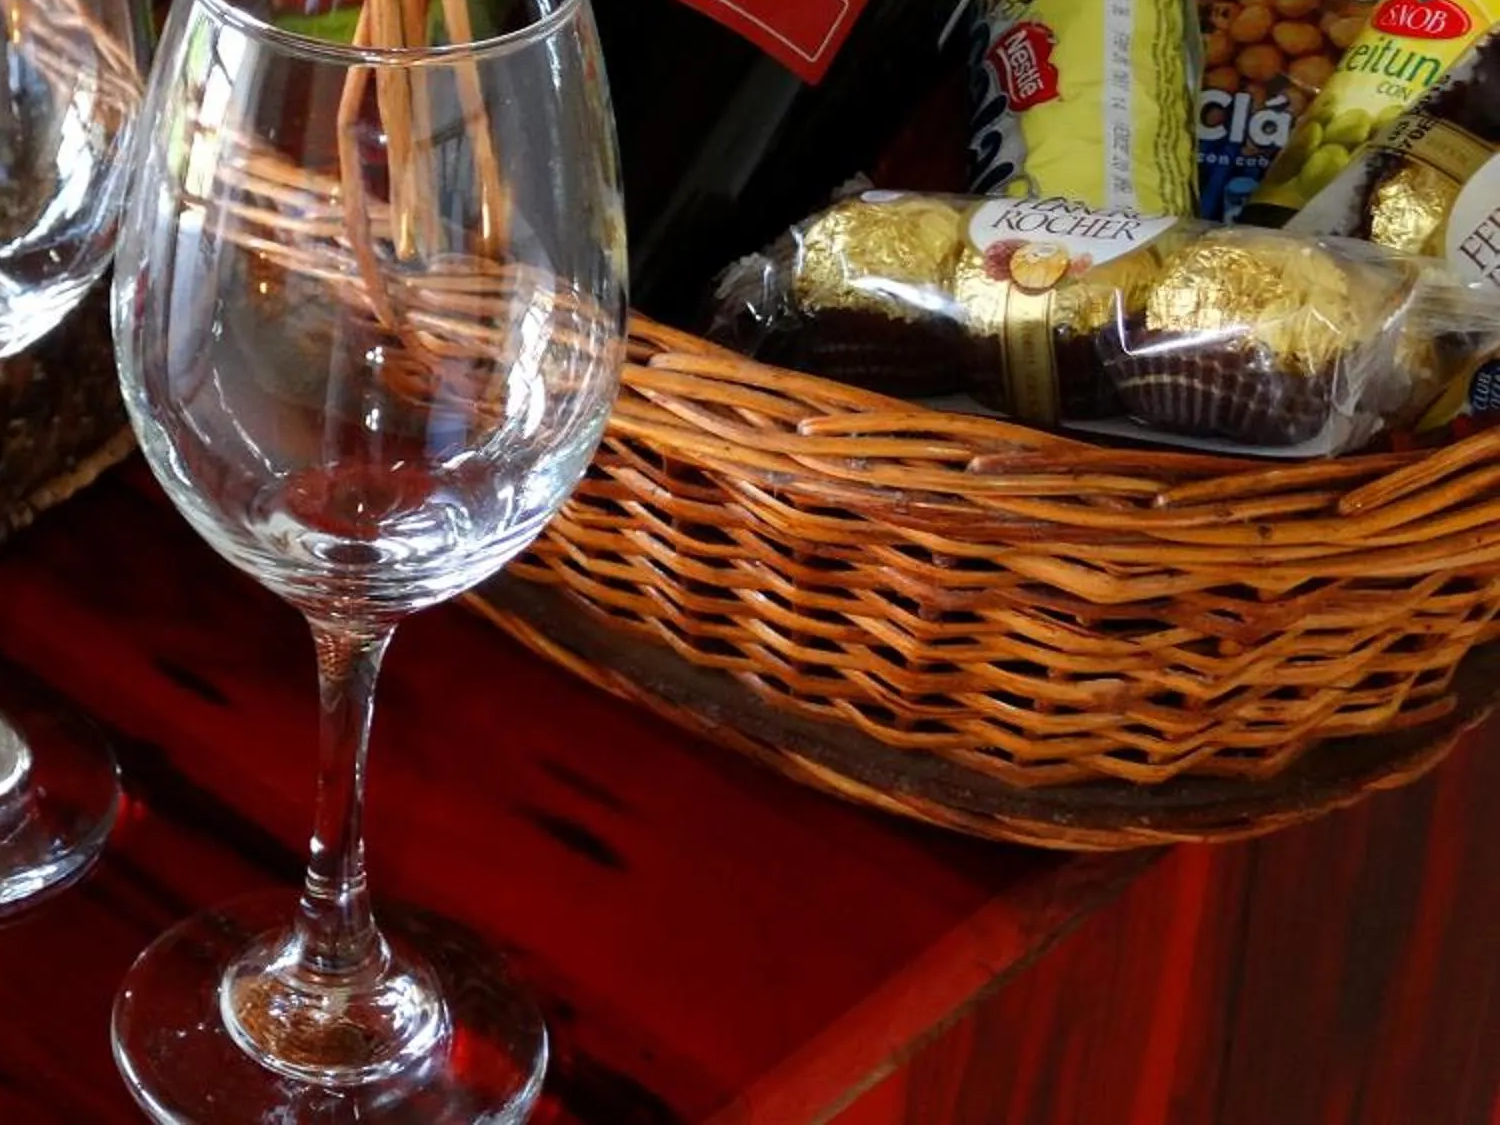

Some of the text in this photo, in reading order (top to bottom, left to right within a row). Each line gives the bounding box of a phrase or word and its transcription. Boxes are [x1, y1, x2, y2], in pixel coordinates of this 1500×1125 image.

[1380, 3, 1448, 34] SNOB
[1004, 29, 1045, 100] Nestlé
[992, 209, 1142, 242] ROCHER
